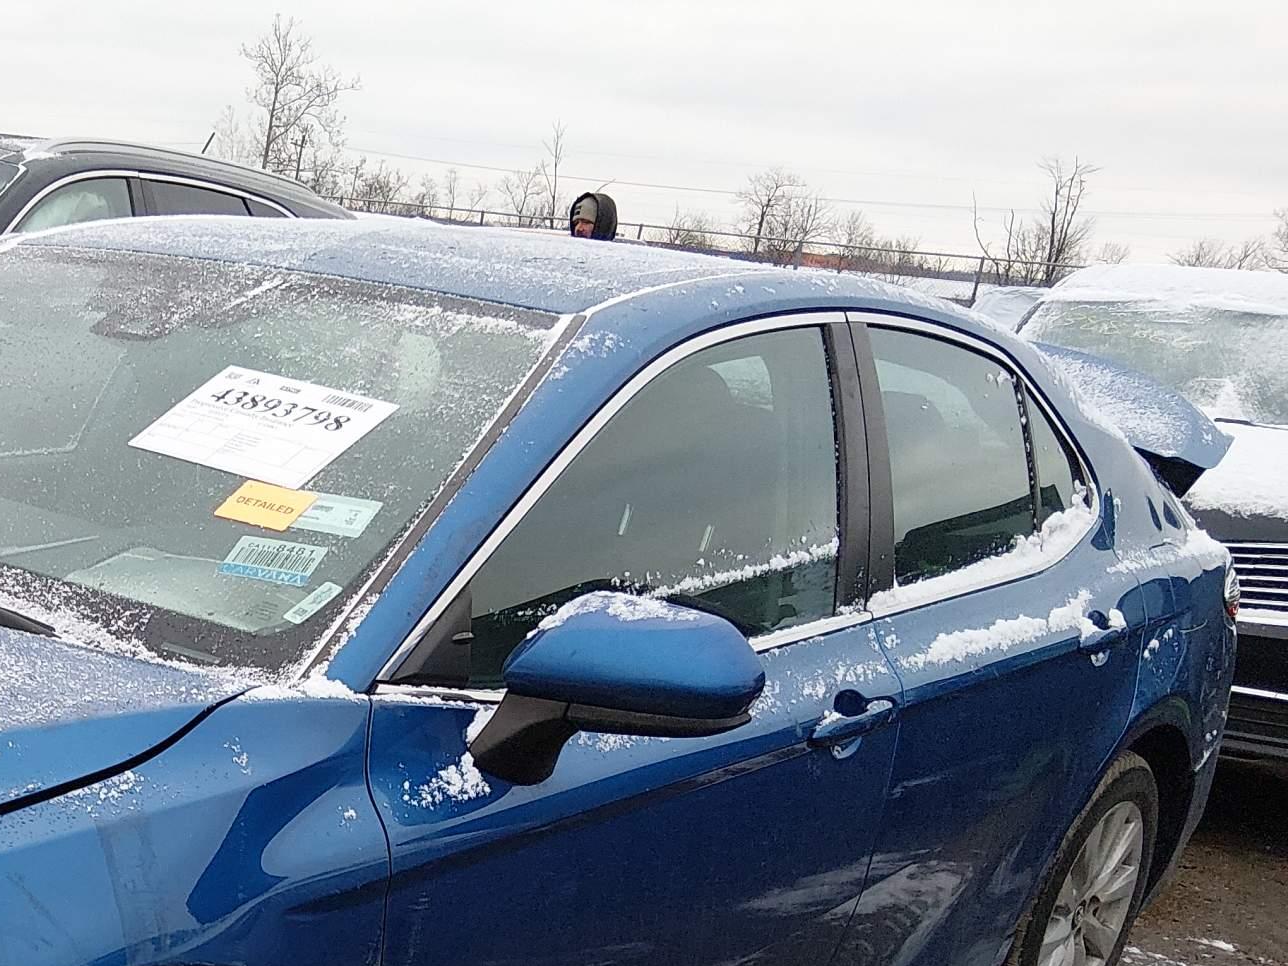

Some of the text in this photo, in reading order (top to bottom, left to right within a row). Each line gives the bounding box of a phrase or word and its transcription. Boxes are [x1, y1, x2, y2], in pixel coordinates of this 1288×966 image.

[210, 388, 352, 432] 43893798
[235, 494, 295, 516] DETAILED
[222, 563, 302, 585] CARVANA
